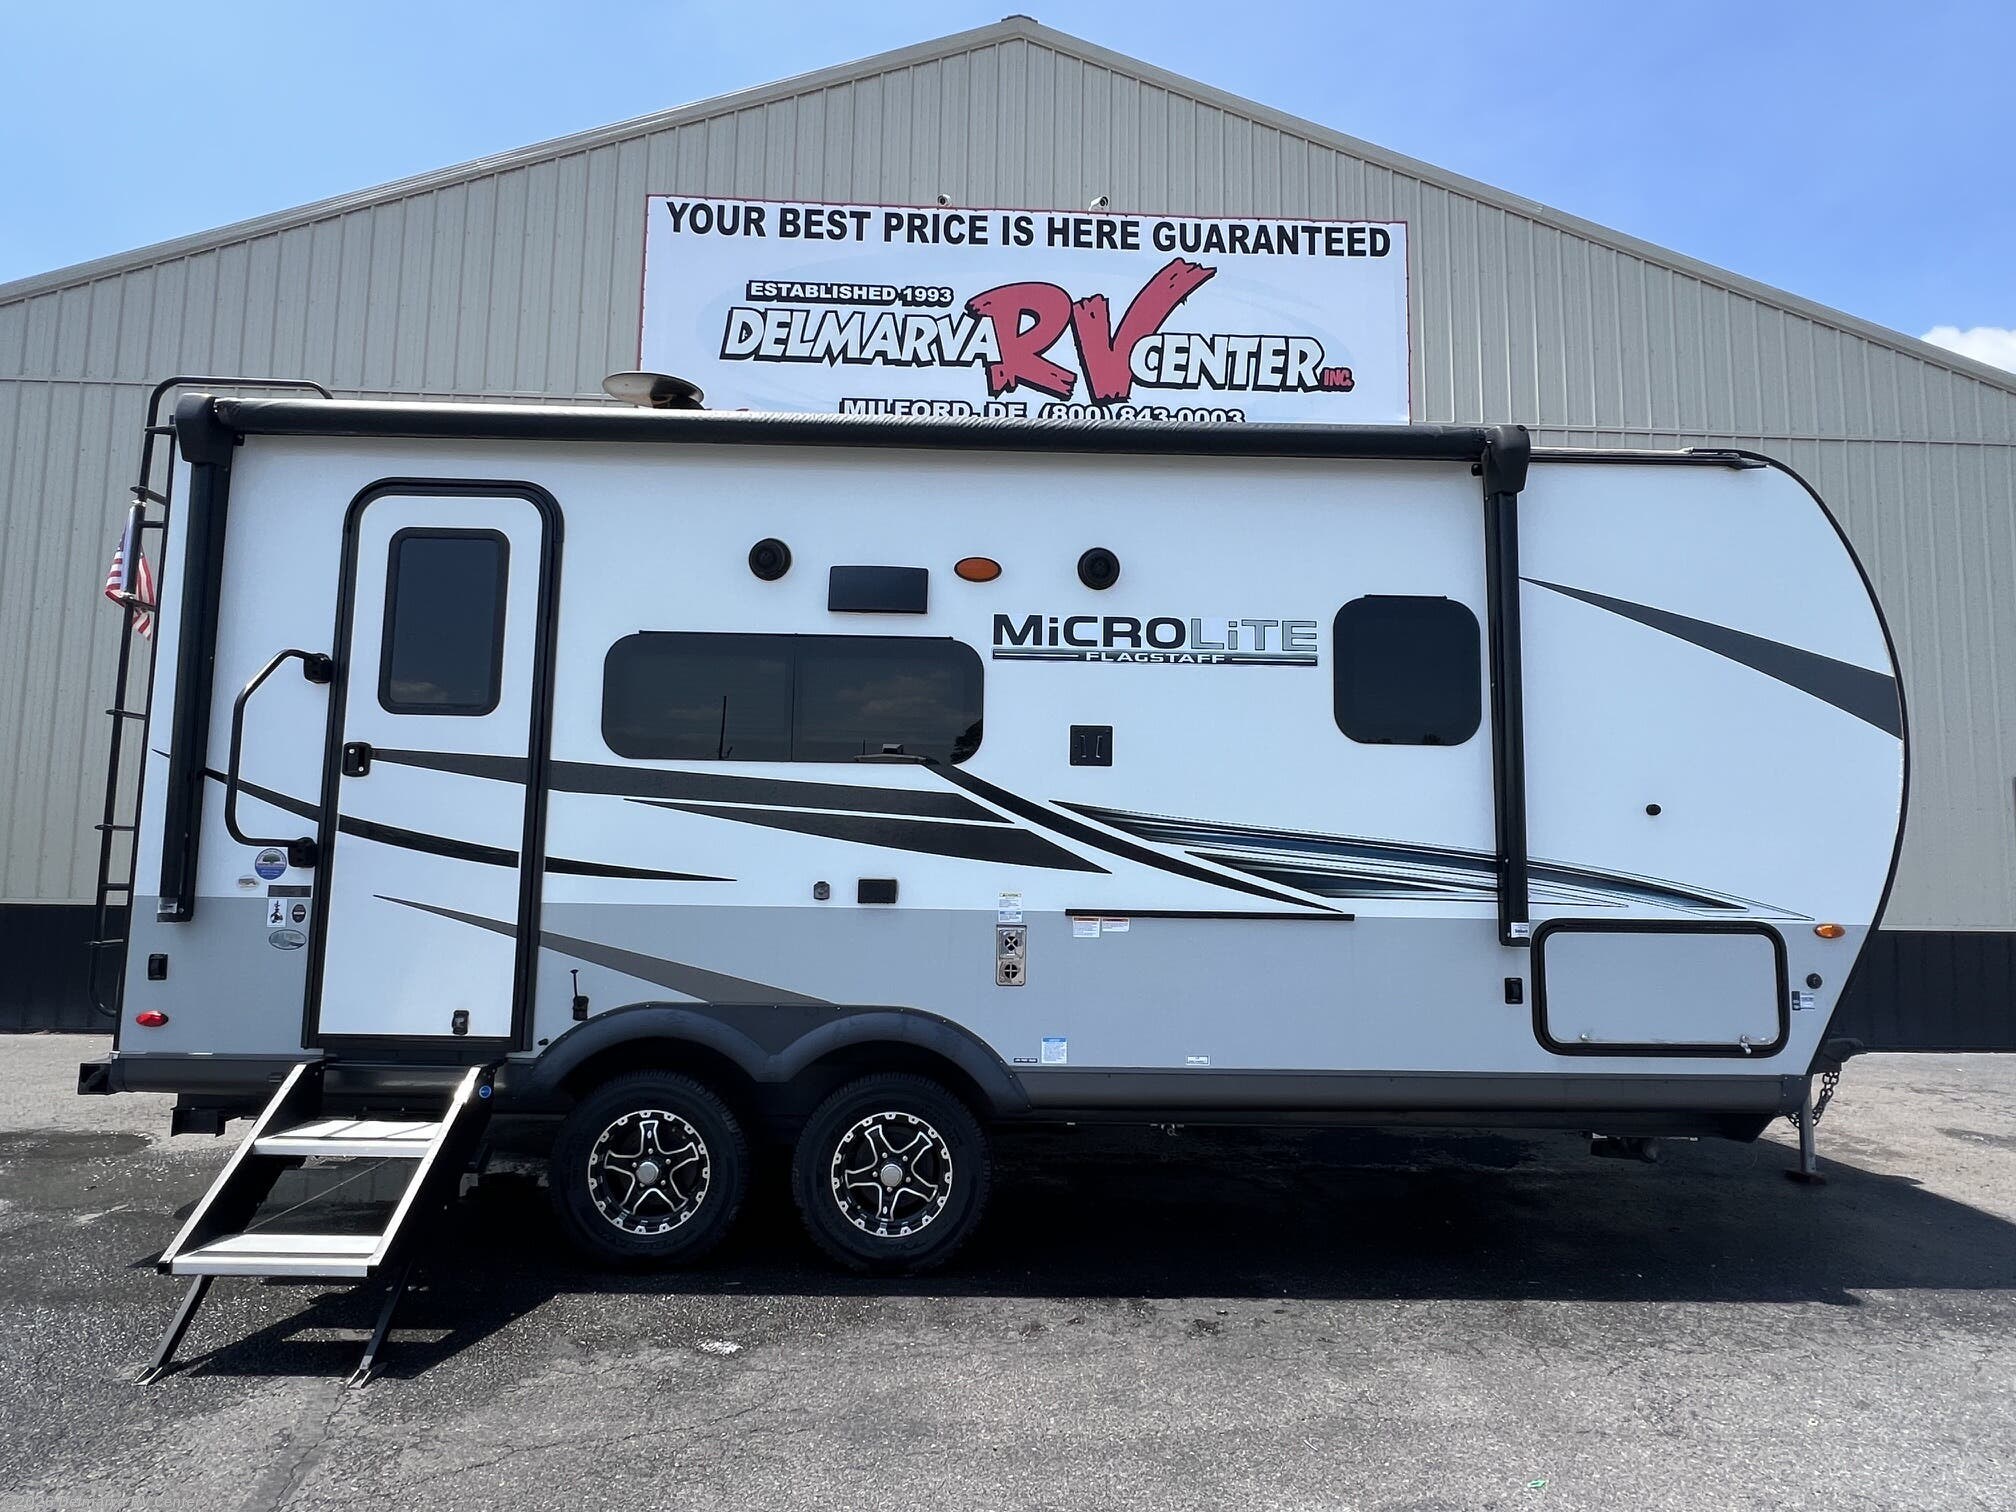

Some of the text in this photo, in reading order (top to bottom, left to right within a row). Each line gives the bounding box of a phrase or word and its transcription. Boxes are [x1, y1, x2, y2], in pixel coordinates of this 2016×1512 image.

[666, 201, 1392, 257] YOUR BEST PRICE IS HERE GUARANTEED
[748, 281, 954, 306] ESTABLISHED 1993
[719, 307, 1003, 368] DELMARVA
[964, 256, 1218, 405] RV
[1128, 332, 1326, 392] CENTER
[984, 401, 1028, 419] DE
[1039, 403, 1112, 421] (800)
[1116, 405, 1245, 423] 843-0003
[1085, 650, 1226, 664] FLAGSTAFF
